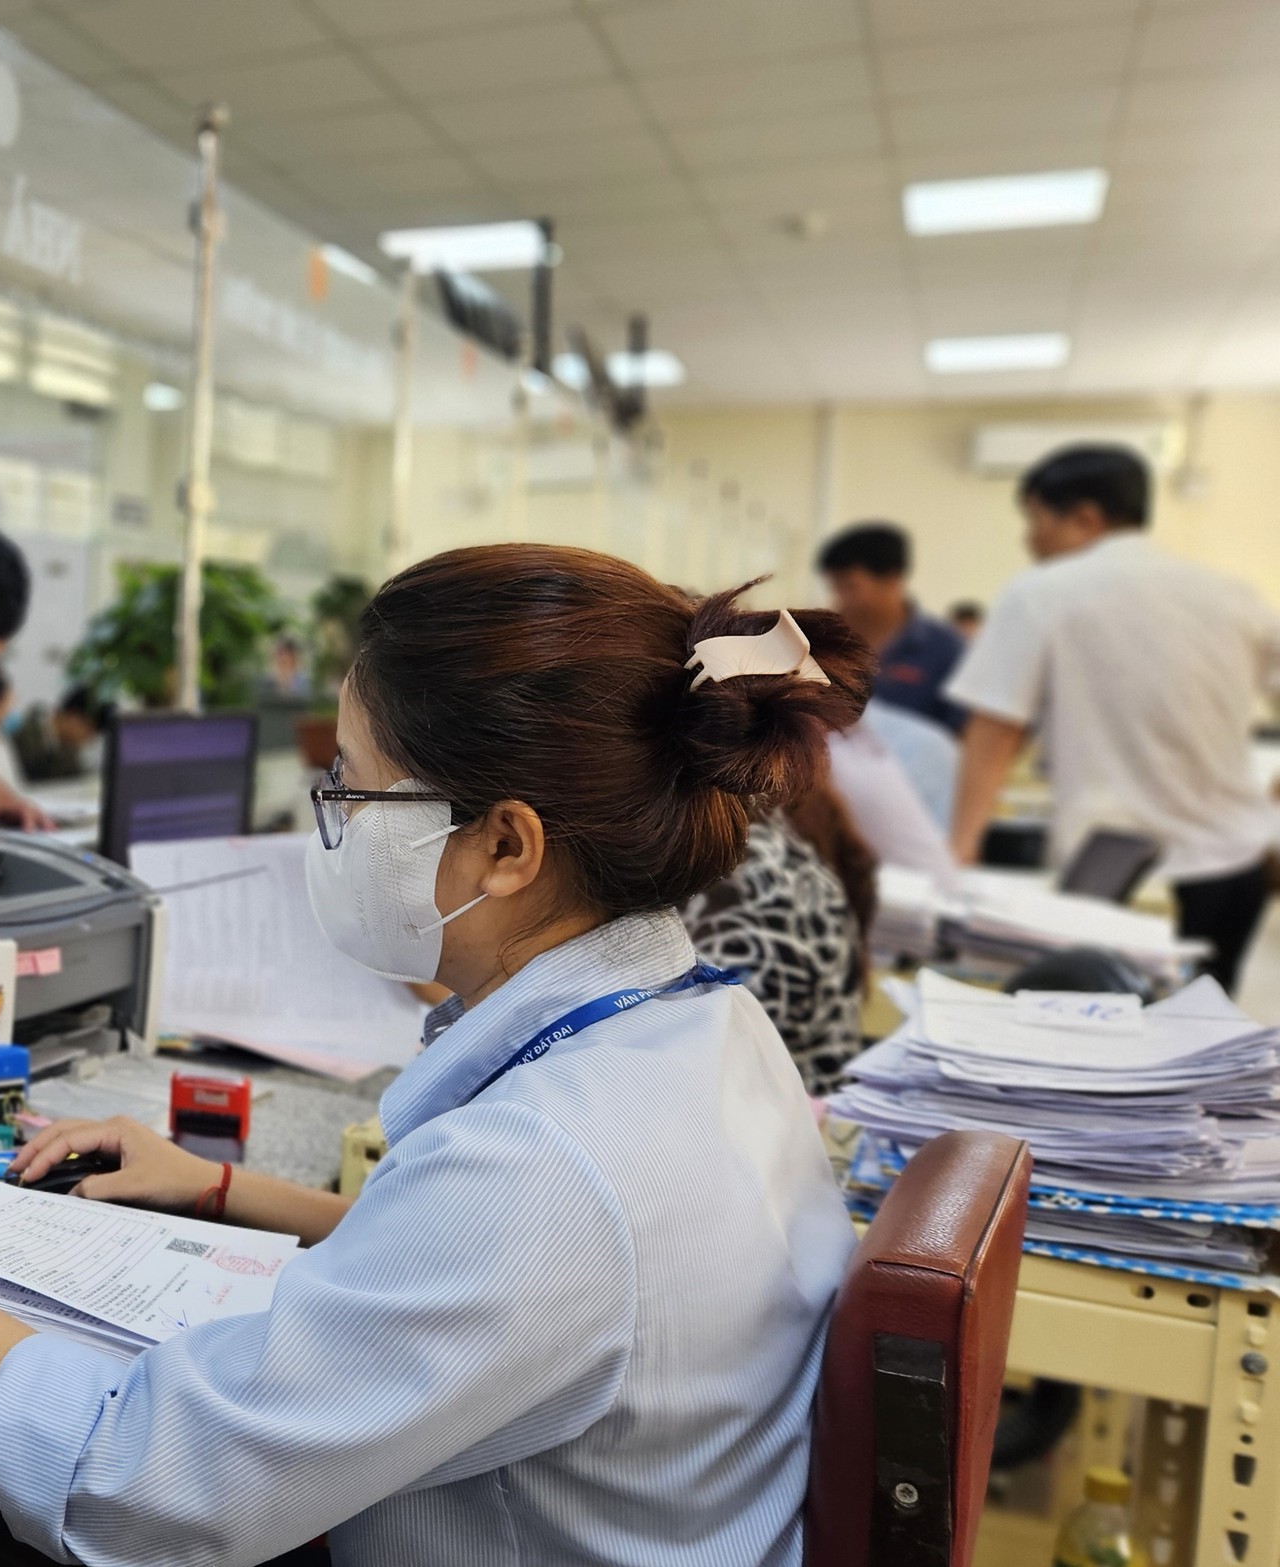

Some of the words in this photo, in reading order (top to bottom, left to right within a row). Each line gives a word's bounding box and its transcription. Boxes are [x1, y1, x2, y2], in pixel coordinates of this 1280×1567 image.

[614, 994, 640, 1009] VĂN
[532, 1034, 554, 1055] ĐẤT
[552, 1023, 574, 1041] ĐAI
